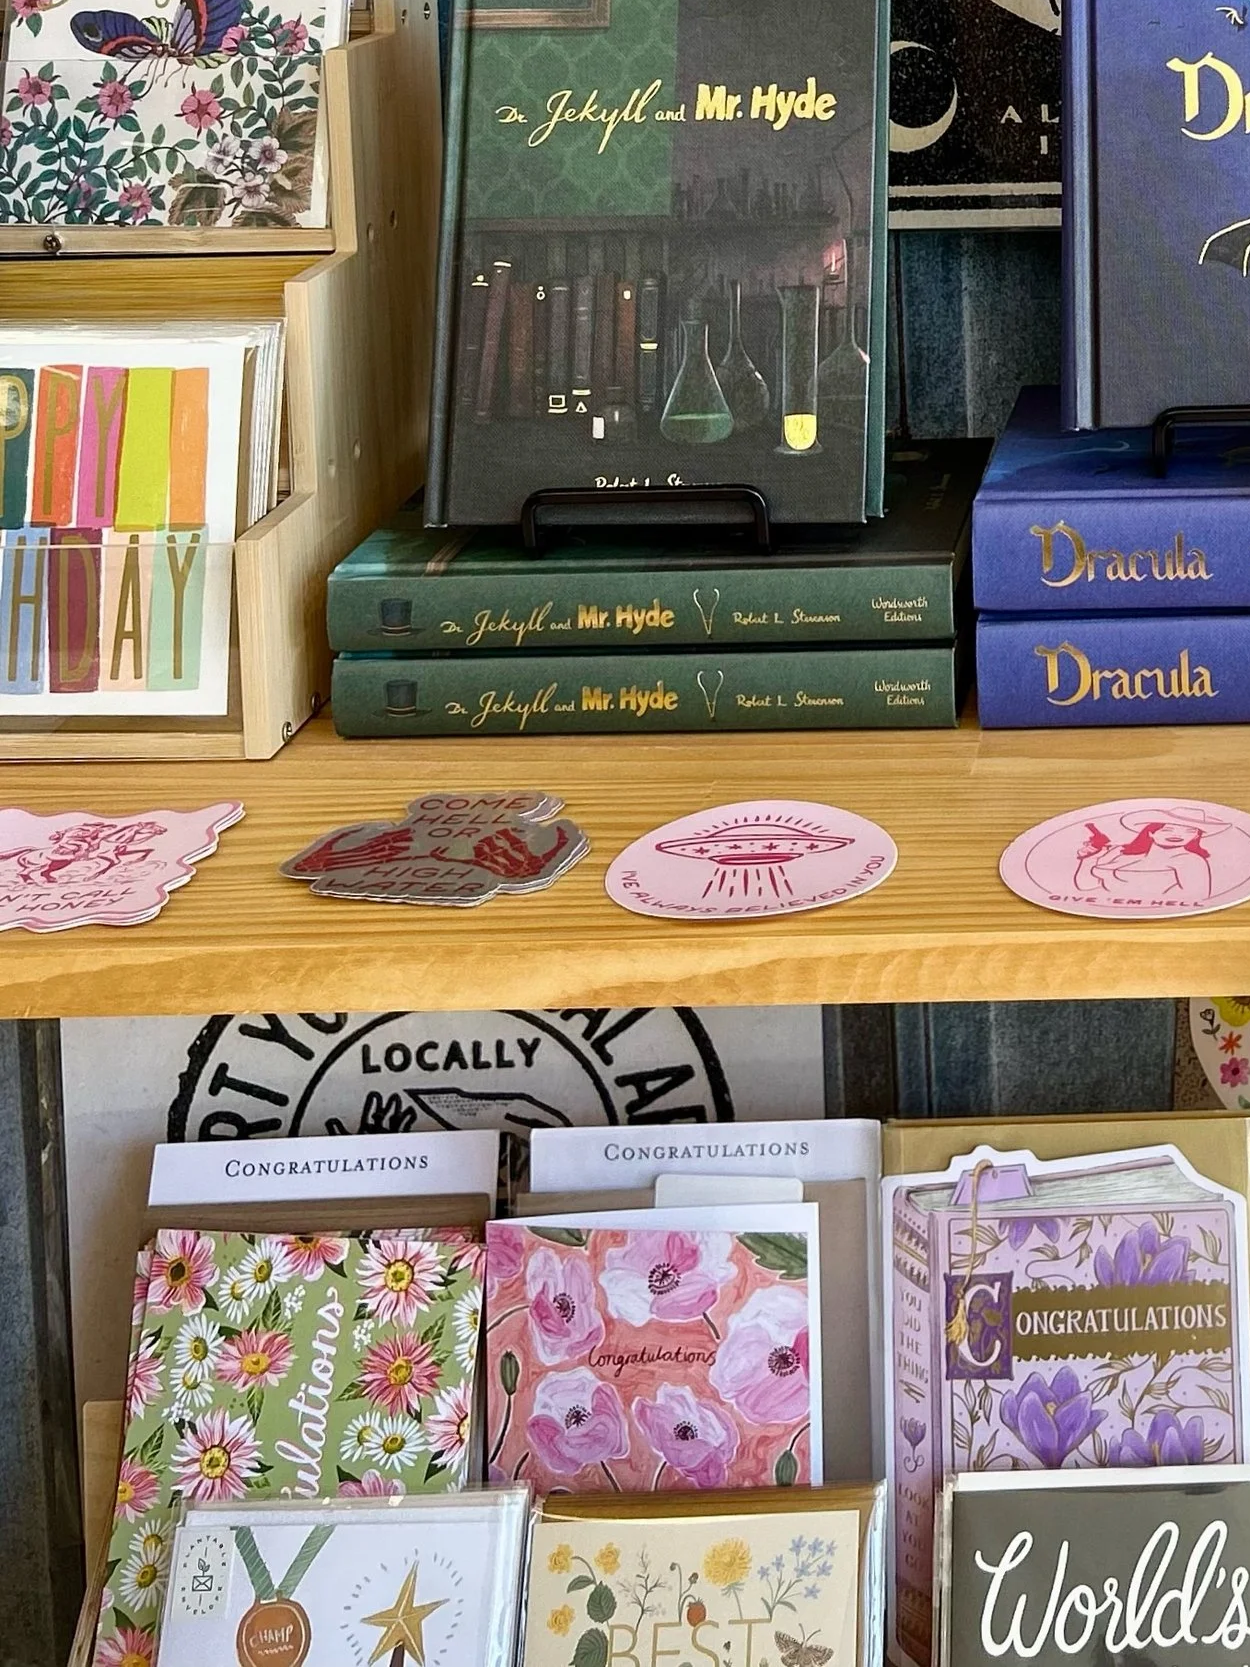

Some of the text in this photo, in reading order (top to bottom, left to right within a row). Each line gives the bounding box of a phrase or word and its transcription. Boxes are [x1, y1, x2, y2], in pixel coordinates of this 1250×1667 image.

[527, 78, 663, 155] Jekyll
[654, 104, 687, 123] and
[694, 82, 743, 122] Mr.
[750, 76, 838, 131] Hyde
[0, 372, 126, 518] PPY
[1029, 519, 1215, 589] Dracula
[7, 533, 202, 683] HDAY
[871, 595, 928, 610] Wordsworth
[466, 600, 554, 646] Jekyll
[550, 618, 572, 631] and
[577, 603, 611, 630] Mr.
[615, 597, 676, 635] Hyde
[731, 611, 768, 626] Robert
[790, 607, 841, 626] Stevenson
[883, 610, 923, 623] Editions
[1033, 639, 1220, 707] Dracula
[873, 678, 931, 693] Wordsworth
[470, 681, 559, 731] Jekyll
[553, 700, 576, 713] and
[581, 685, 615, 712] Mr.
[619, 679, 680, 718] Hyde
[735, 693, 772, 708] Robert
[793, 690, 845, 708] Stevenson
[886, 693, 925, 707] Editions
[420, 796, 534, 811] COME
[412, 813, 512, 825] HELL
[427, 827, 482, 839] OR
[363, 866, 475, 879] HIGH
[60, 887, 137, 901] CALL
[325, 879, 486, 893] WATER
[620, 854, 886, 914] I'VE ALWAYS BELIEVED IN YOU
[15, 896, 125, 913] HONEY
[1048, 894, 1097, 903] GIVE
[1150, 900, 1205, 908] HELL
[360, 1036, 543, 1075] LOCALLY
[602, 1140, 811, 1164] CONGRATULATIONS
[224, 1152, 430, 1179] CONGRATULATIONS
[953, 1279, 1229, 1368] CONGRATULATIONS
[587, 1345, 718, 1383] Congratulations
[249, 1624, 295, 1648] CHAMP
